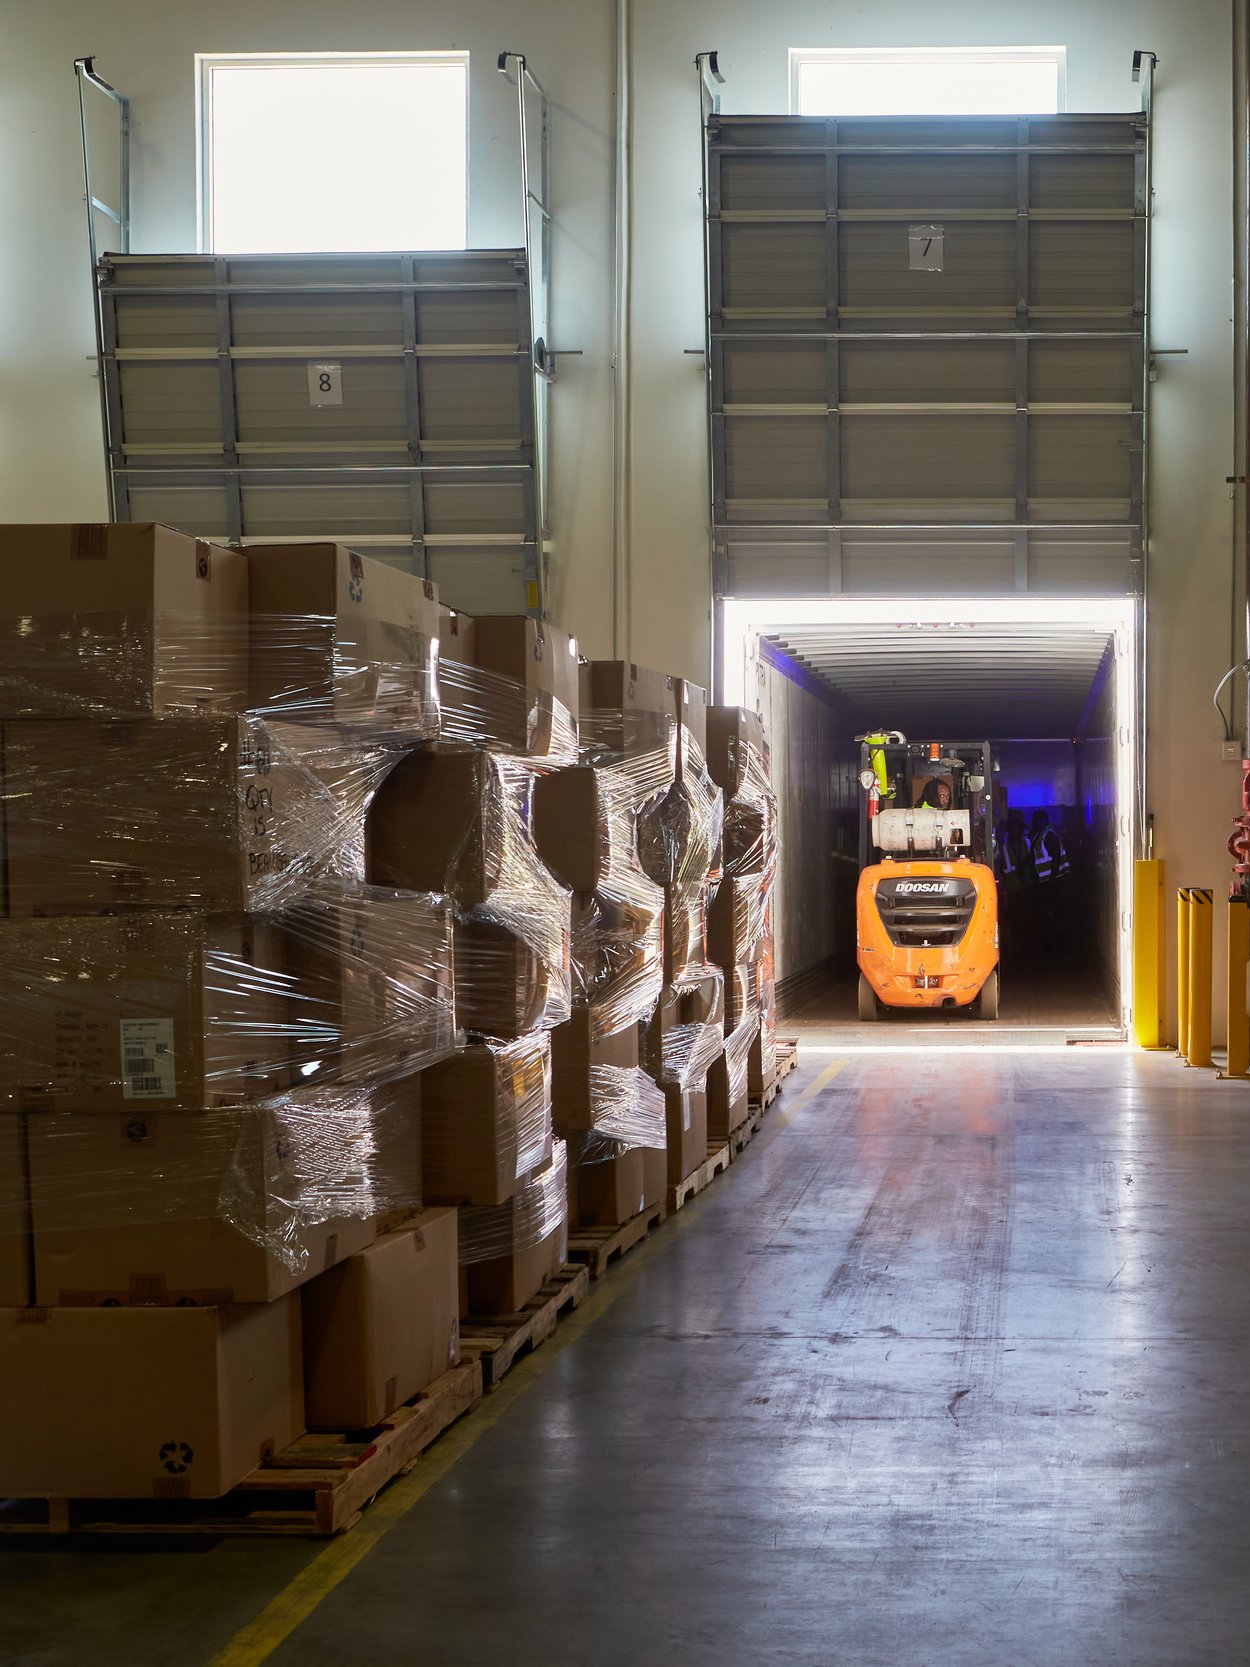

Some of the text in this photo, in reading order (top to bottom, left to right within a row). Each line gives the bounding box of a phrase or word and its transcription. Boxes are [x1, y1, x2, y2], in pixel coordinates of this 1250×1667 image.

[920, 237, 932, 257] 7
[319, 373, 331, 392] 8
[245, 784, 273, 812] QTY
[254, 815, 266, 836] 15
[895, 883, 949, 893] DOOSAN
